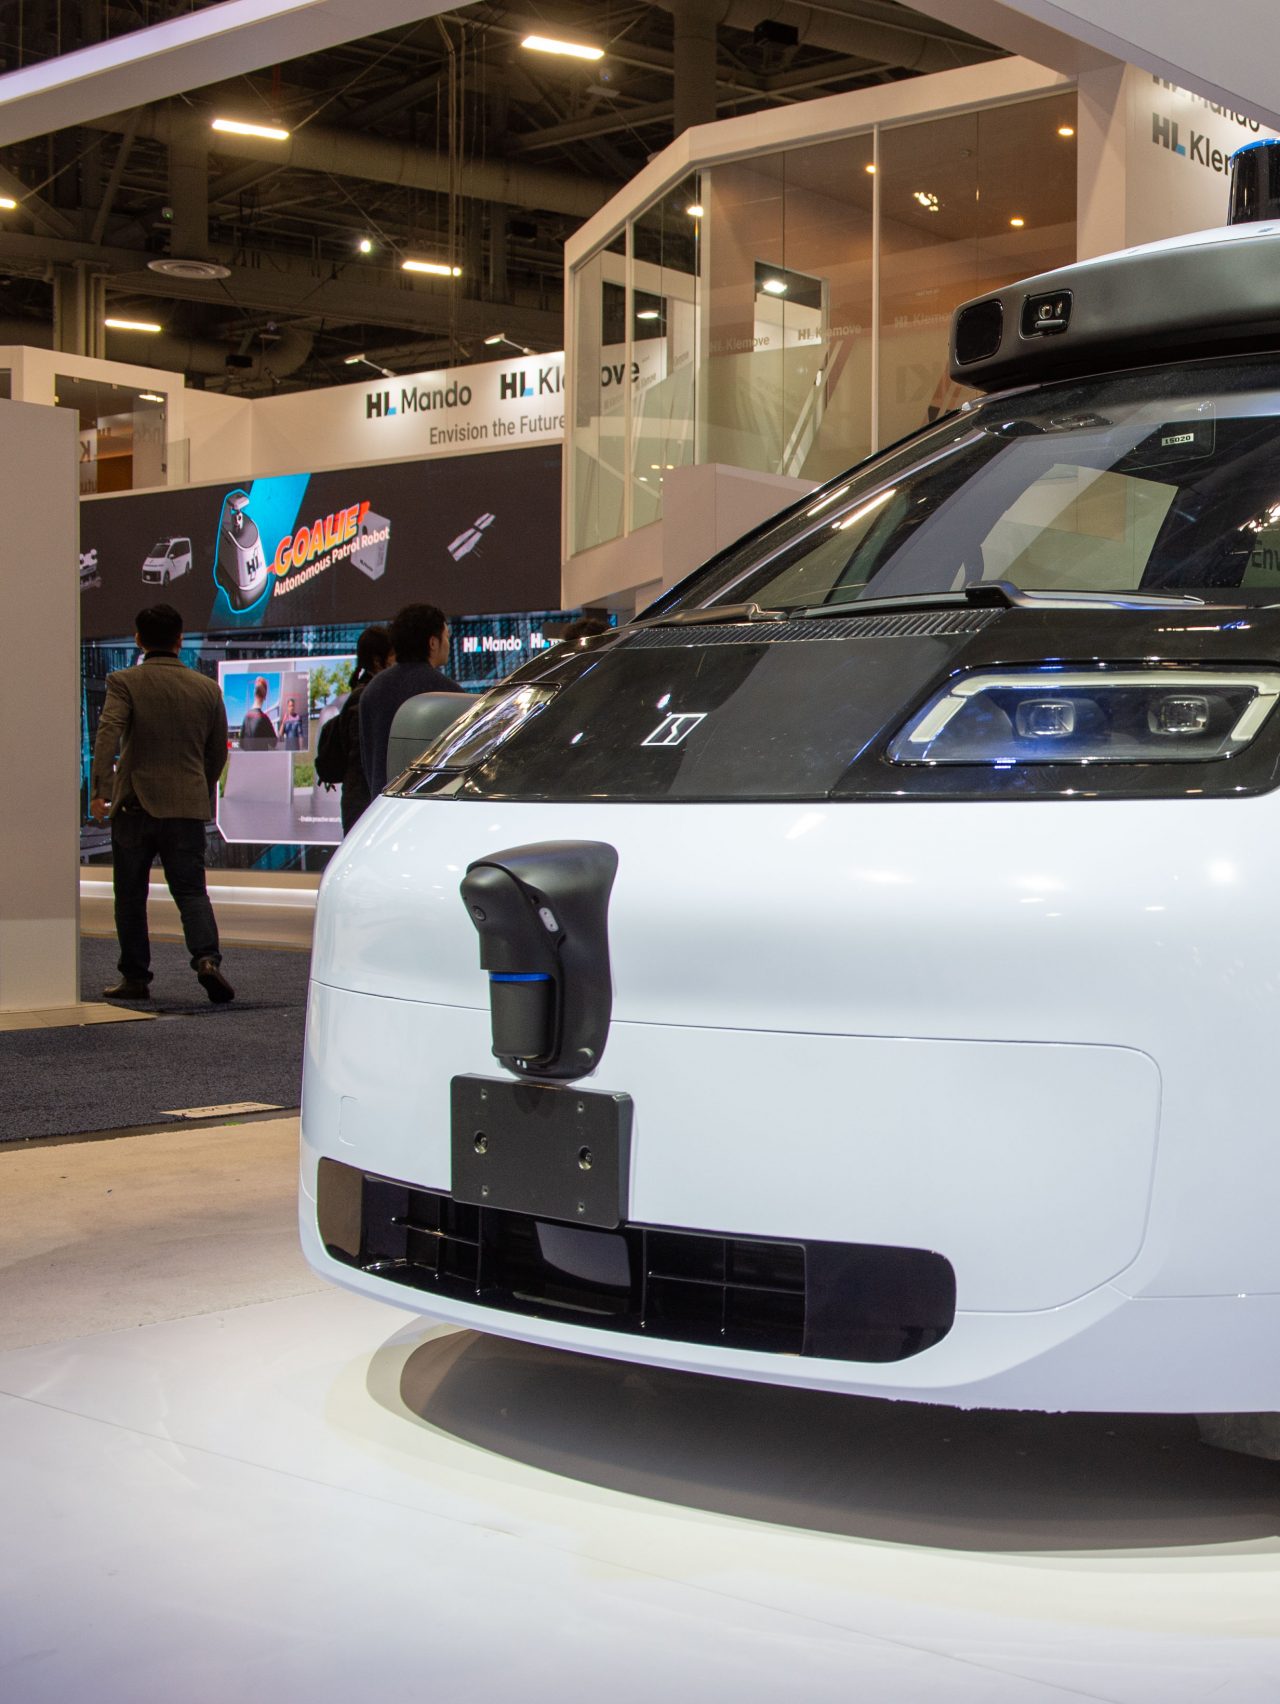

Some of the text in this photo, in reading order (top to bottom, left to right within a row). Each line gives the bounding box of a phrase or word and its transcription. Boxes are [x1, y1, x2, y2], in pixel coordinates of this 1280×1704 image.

[1152, 112, 1186, 157] HL
[726, 335, 770, 352] Klemove
[366, 380, 472, 419] HL Mando
[500, 371, 534, 400] HL
[430, 412, 566, 445] Envision the Future
[274, 555, 331, 597] Autonomous
[331, 537, 360, 563] Patrol
[361, 526, 390, 549] Robot
[463, 635, 522, 653] HL Mando
